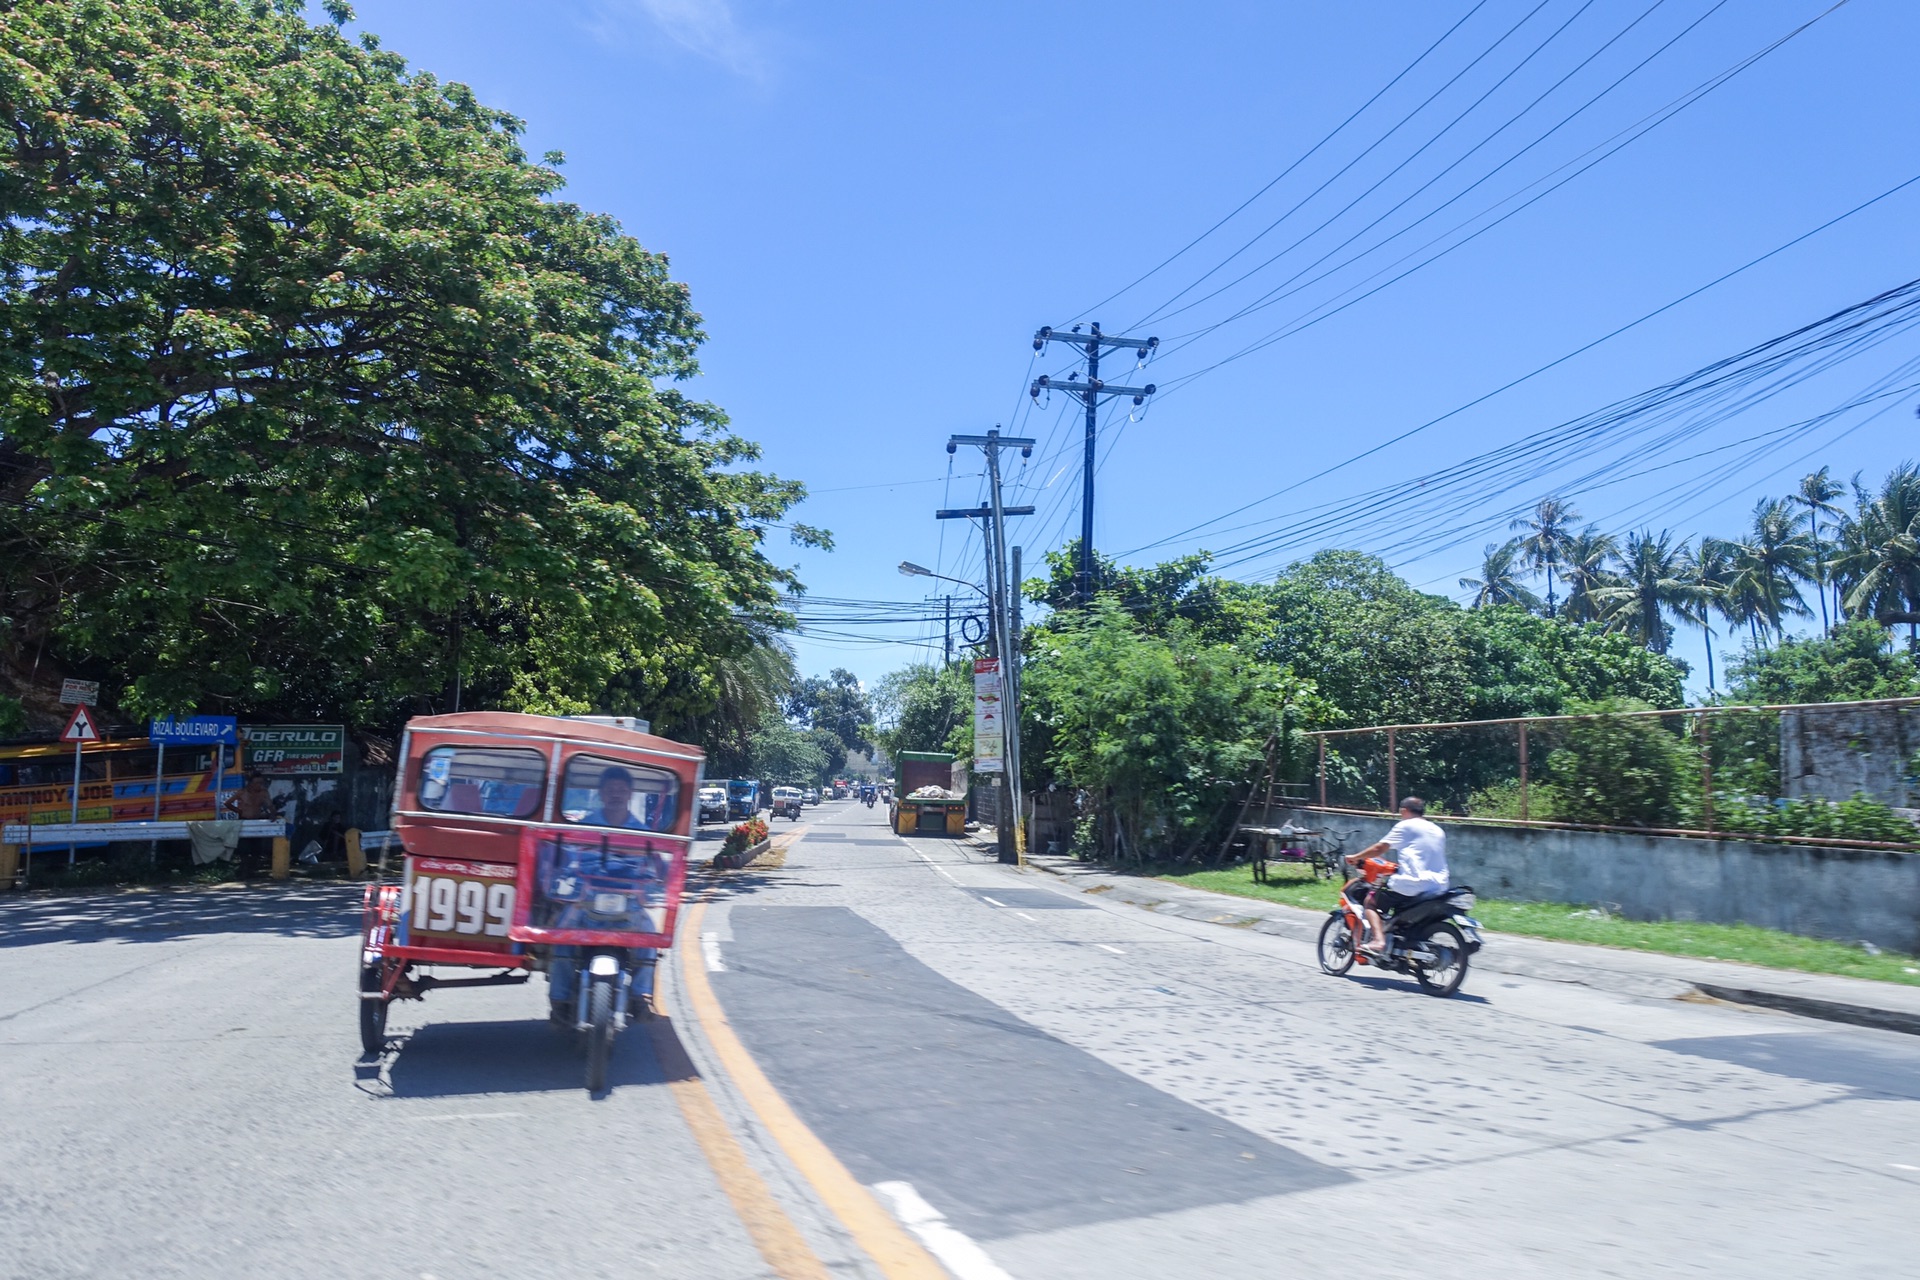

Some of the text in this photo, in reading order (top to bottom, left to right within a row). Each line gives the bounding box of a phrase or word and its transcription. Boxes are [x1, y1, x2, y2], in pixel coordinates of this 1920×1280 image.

[152, 721, 219, 737] RIZAL BOULEVARD
[253, 750, 285, 762] GFR
[78, 784, 113, 800] JOE
[413, 876, 517, 937] 1999
